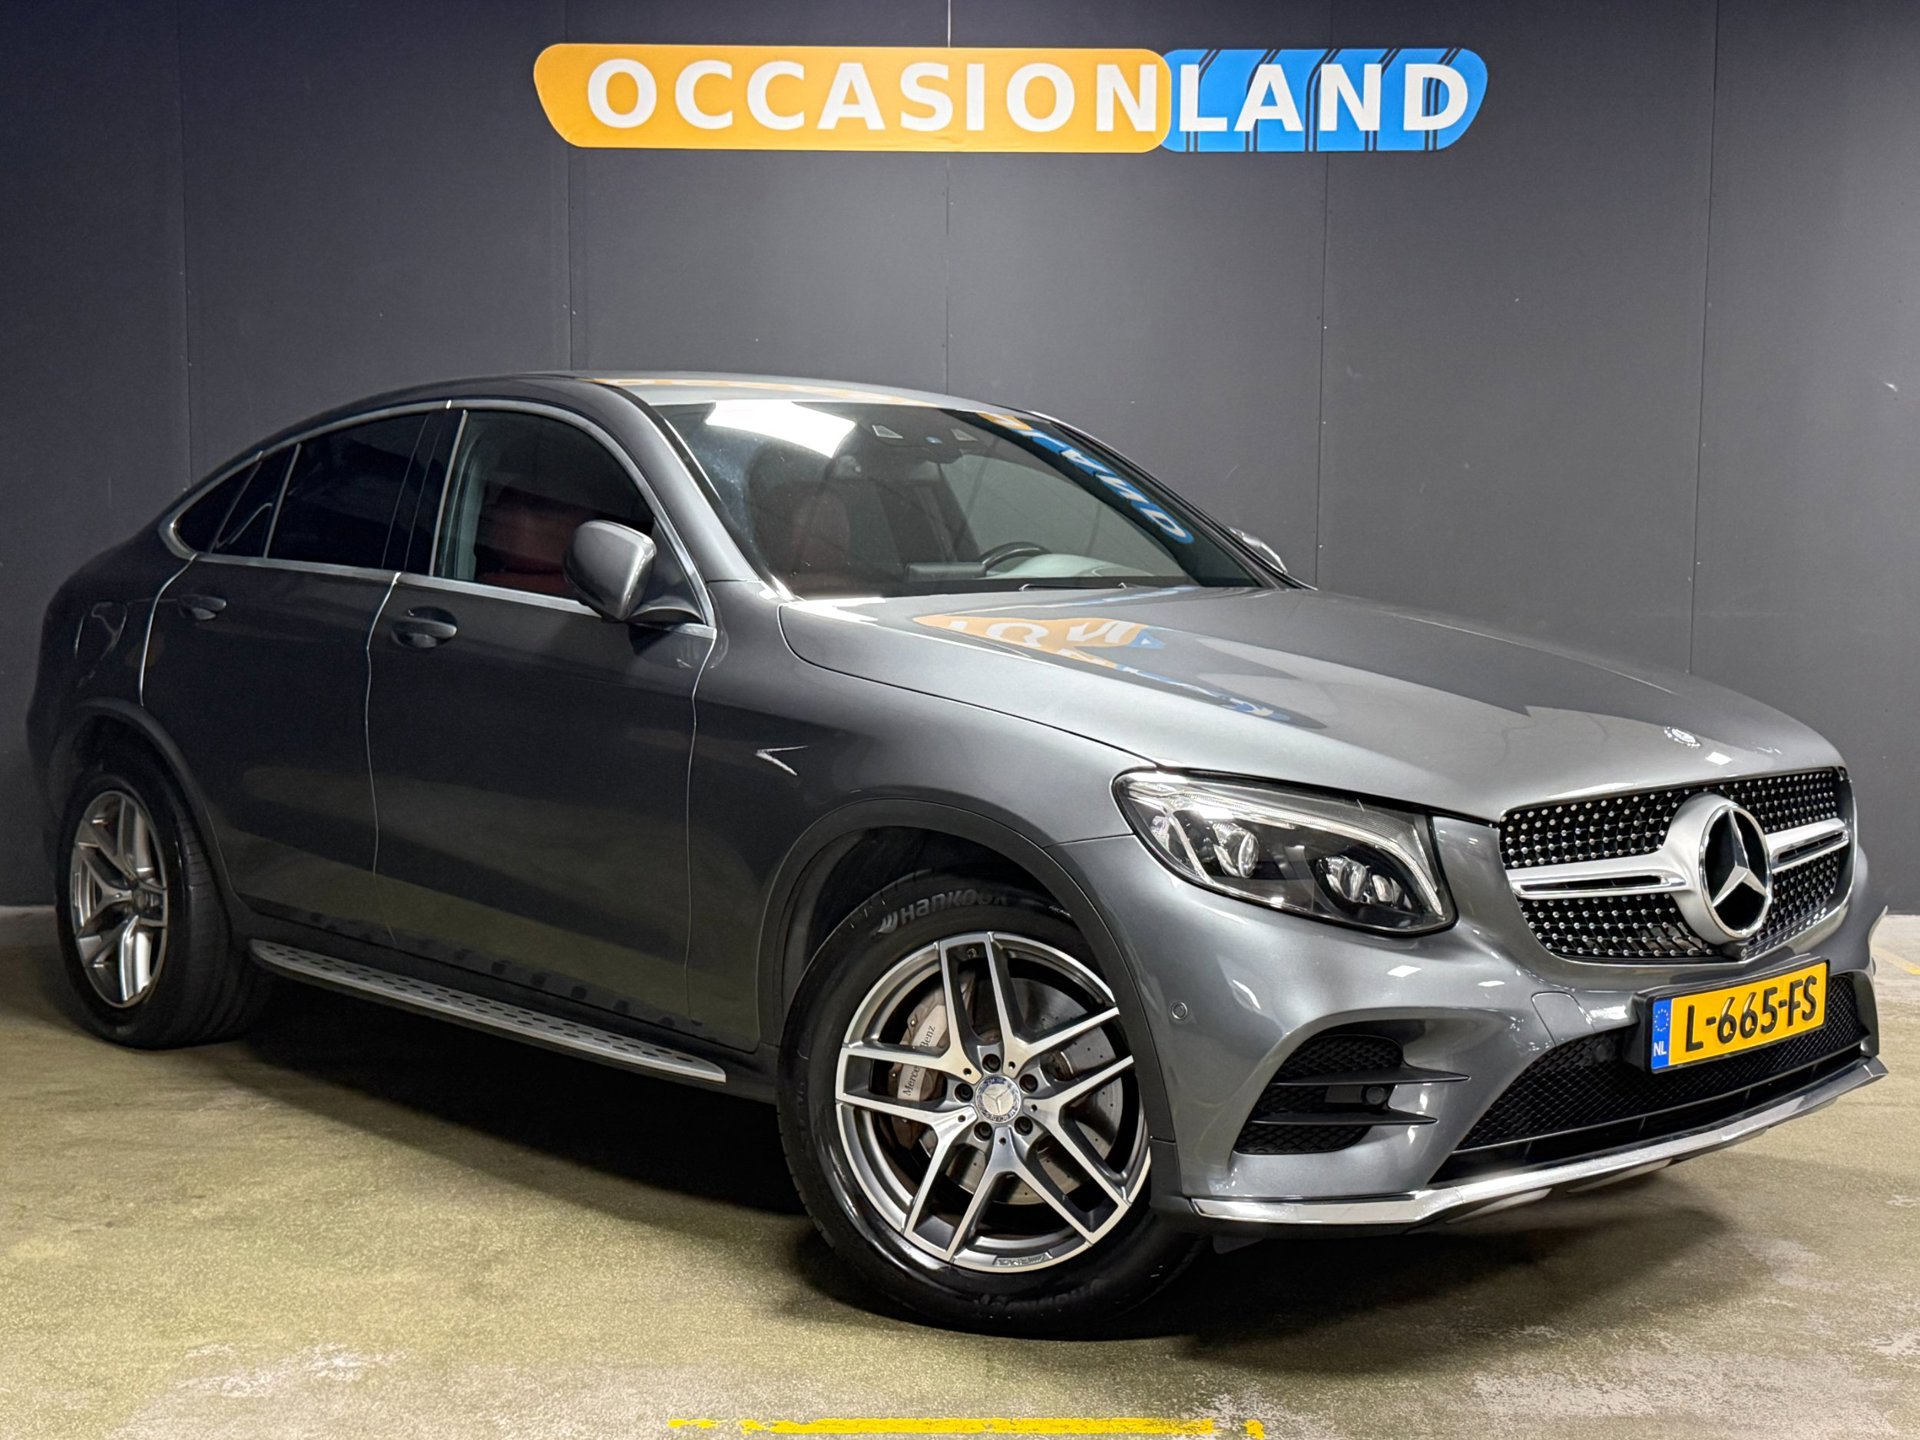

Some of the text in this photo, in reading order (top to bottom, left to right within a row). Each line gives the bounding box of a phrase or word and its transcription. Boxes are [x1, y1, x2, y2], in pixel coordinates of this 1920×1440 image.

[586, 59, 1470, 133] OCCASIONLAND
[1653, 1041, 1667, 1056] NL
[1685, 974, 1817, 1053] L-665-FS
